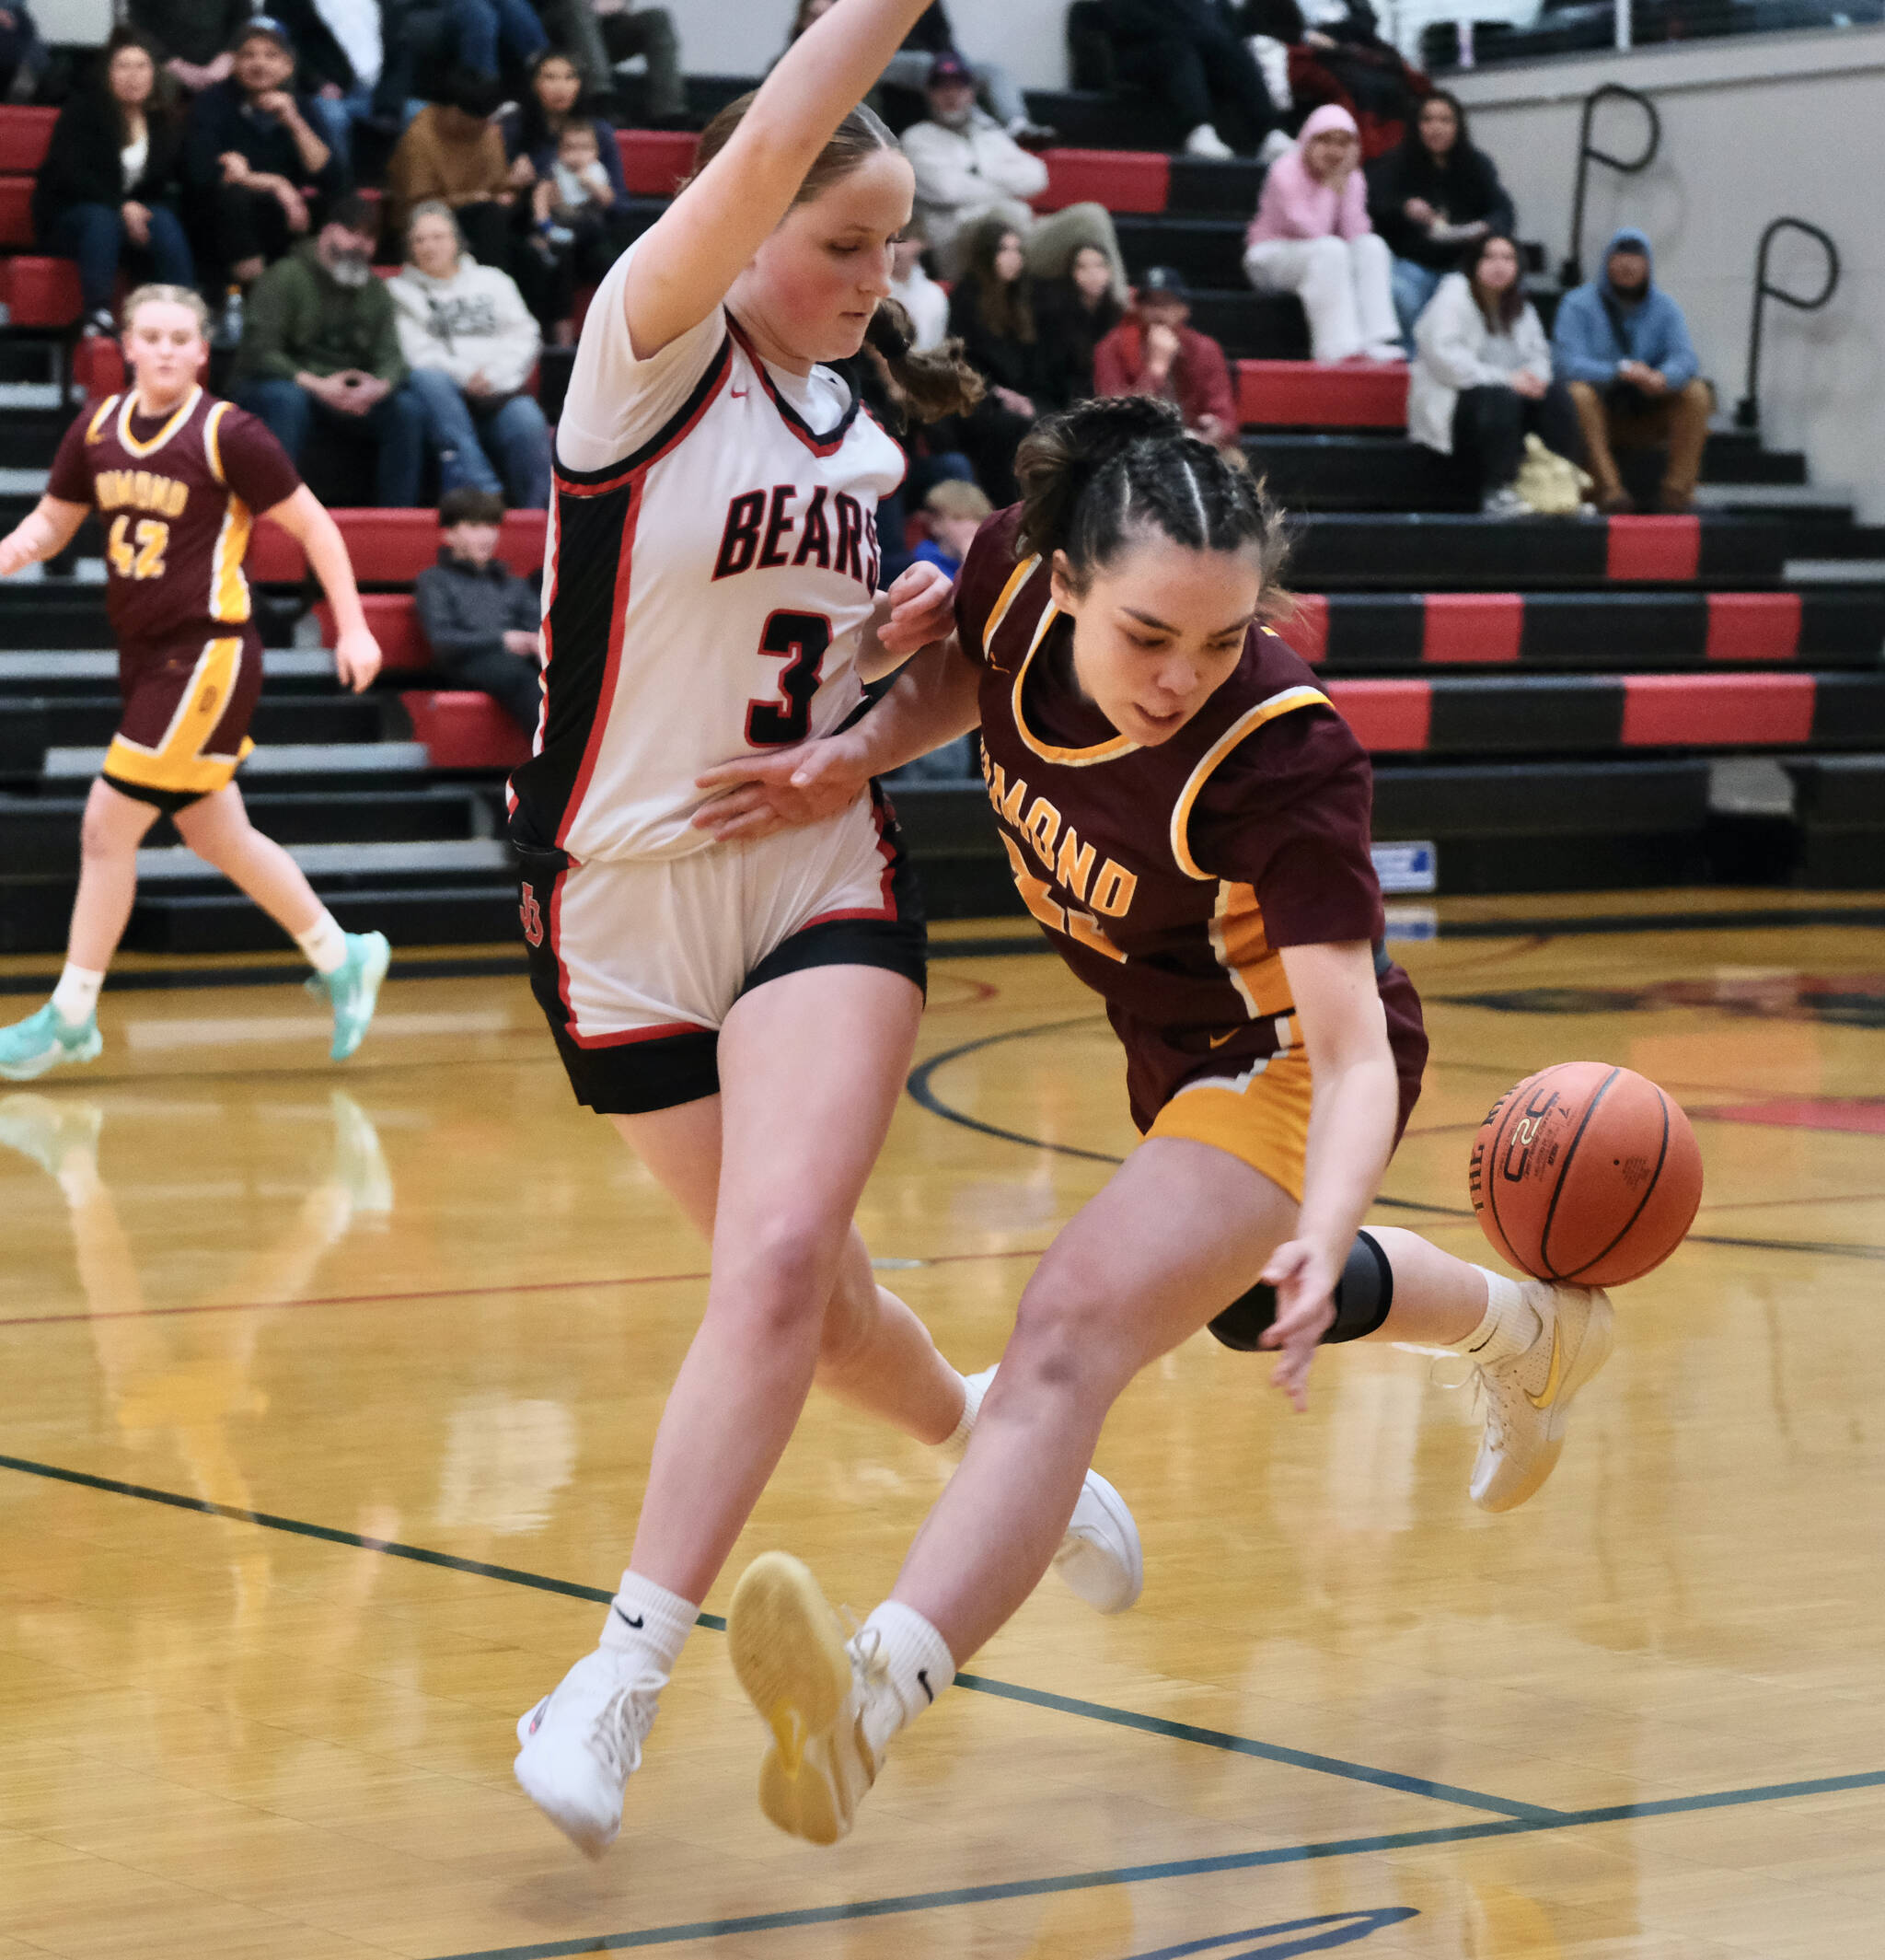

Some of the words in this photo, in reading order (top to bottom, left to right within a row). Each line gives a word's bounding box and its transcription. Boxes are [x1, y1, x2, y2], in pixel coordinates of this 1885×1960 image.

[108, 514, 169, 580] 42
[711, 484, 880, 599] BEARS
[745, 608, 833, 748] 3
